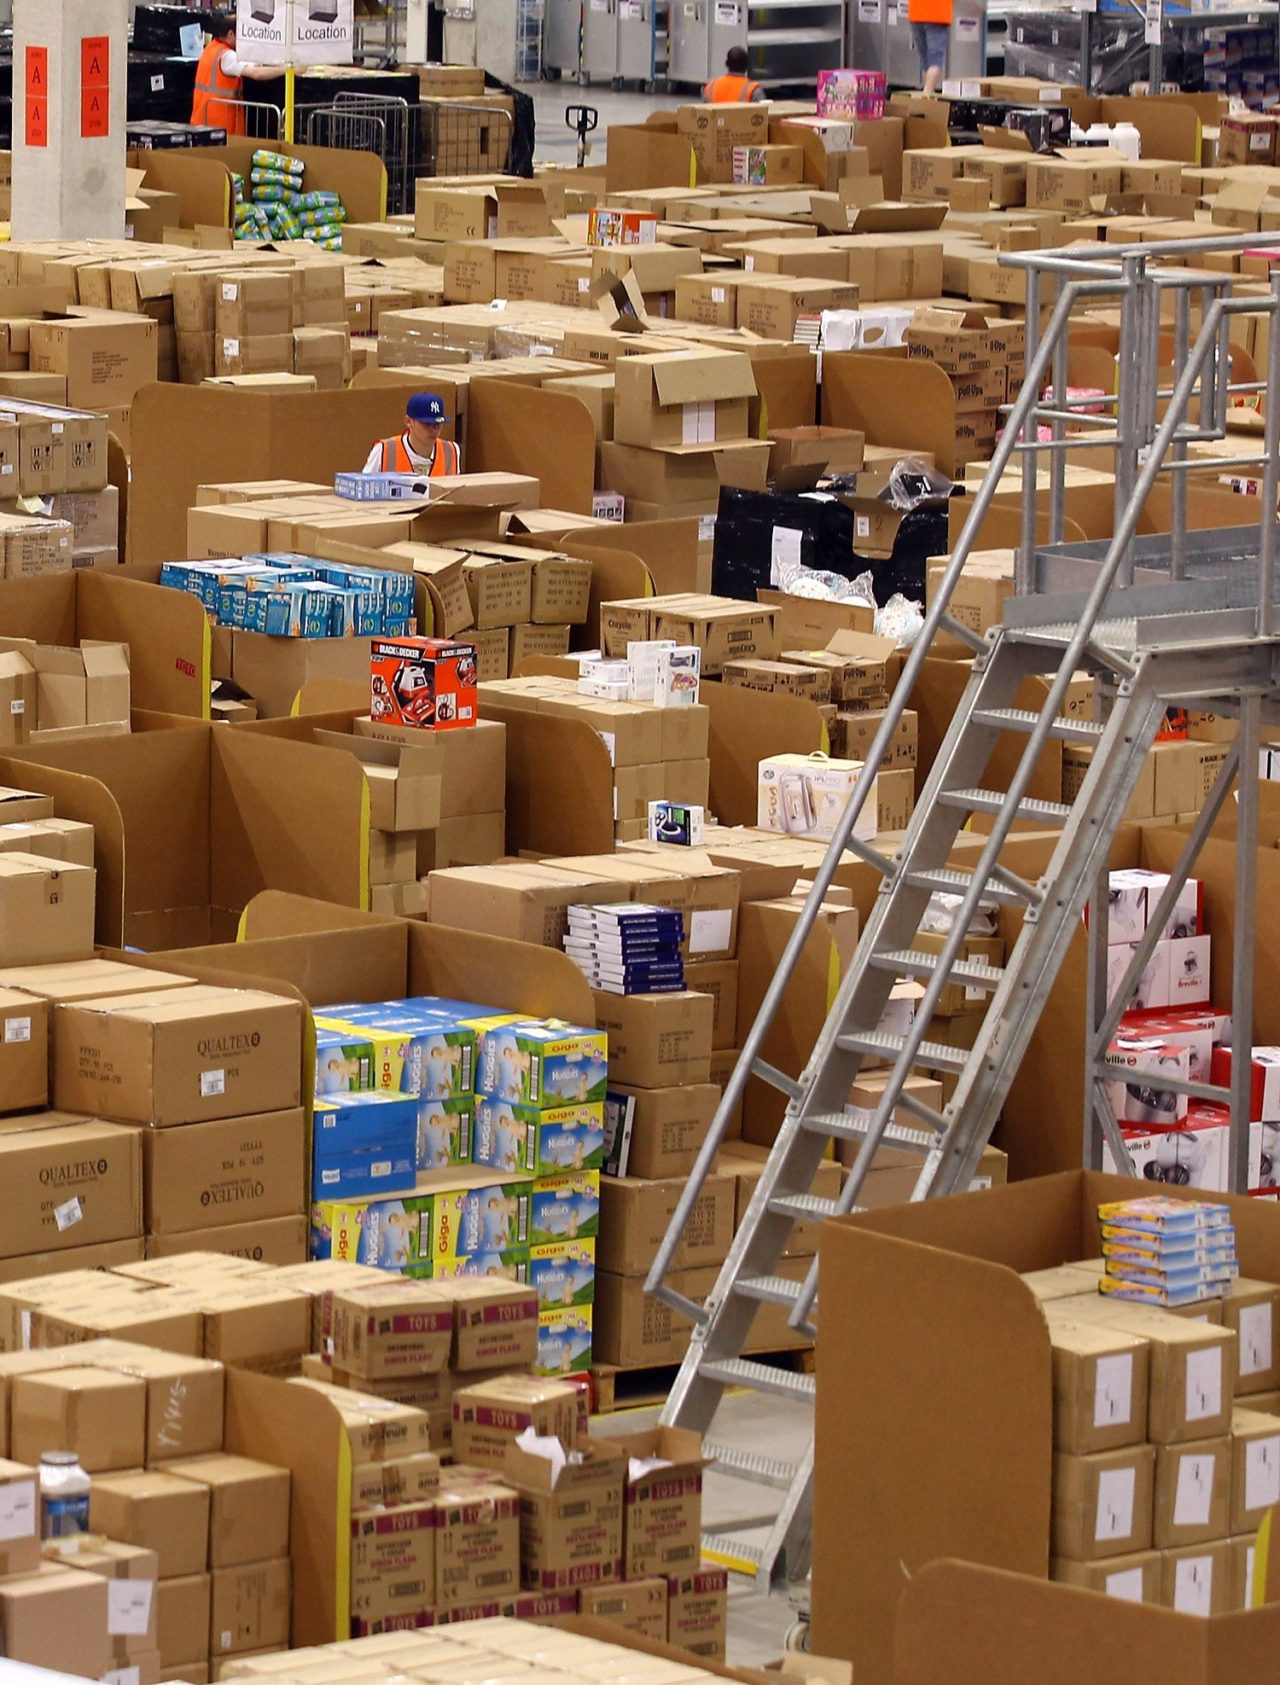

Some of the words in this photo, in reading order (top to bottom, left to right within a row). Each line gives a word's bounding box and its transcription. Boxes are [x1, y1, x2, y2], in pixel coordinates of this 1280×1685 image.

[242, 24, 281, 41] Location
[298, 26, 346, 40] Location
[89, 57, 100, 74] A
[32, 67, 40, 84] A
[91, 97, 100, 111] A
[33, 106, 40, 120] A
[380, 645, 420, 659] BLACK&DECKER
[442, 648, 472, 657] BLACK&DECKER
[1178, 979, 1199, 989] Breville
[197, 1034, 251, 1057] QUALTEX
[552, 1043, 579, 1054] Giga
[484, 1039, 496, 1093] HUGGIES
[1106, 1056, 1126, 1064] ville
[227, 1068, 239, 1077] PCS
[382, 1061, 391, 1088] iga
[410, 1045, 422, 1096] HUGGIES
[547, 1110, 575, 1121] Giga
[480, 1107, 492, 1161] HUGGIES
[39, 1160, 96, 1184] QUALTEX
[540, 1178, 569, 1189] Giga
[40, 1201, 53, 1211] QTY
[468, 1196, 479, 1250] HUGGIES
[368, 1212, 380, 1265] HUGGIES
[439, 1214, 450, 1253] Giga
[536, 1245, 565, 1256] Giga
[498, 1305, 525, 1320] TOYS
[409, 1316, 437, 1330] TOYS
[491, 1410, 518, 1428] TOYS
[655, 1483, 681, 1498] TOYS
[392, 1516, 418, 1530] TOYS
[700, 1575, 723, 1590] TOYS
[533, 1598, 561, 1613] TOYS
[393, 1617, 417, 1630] TOYS
